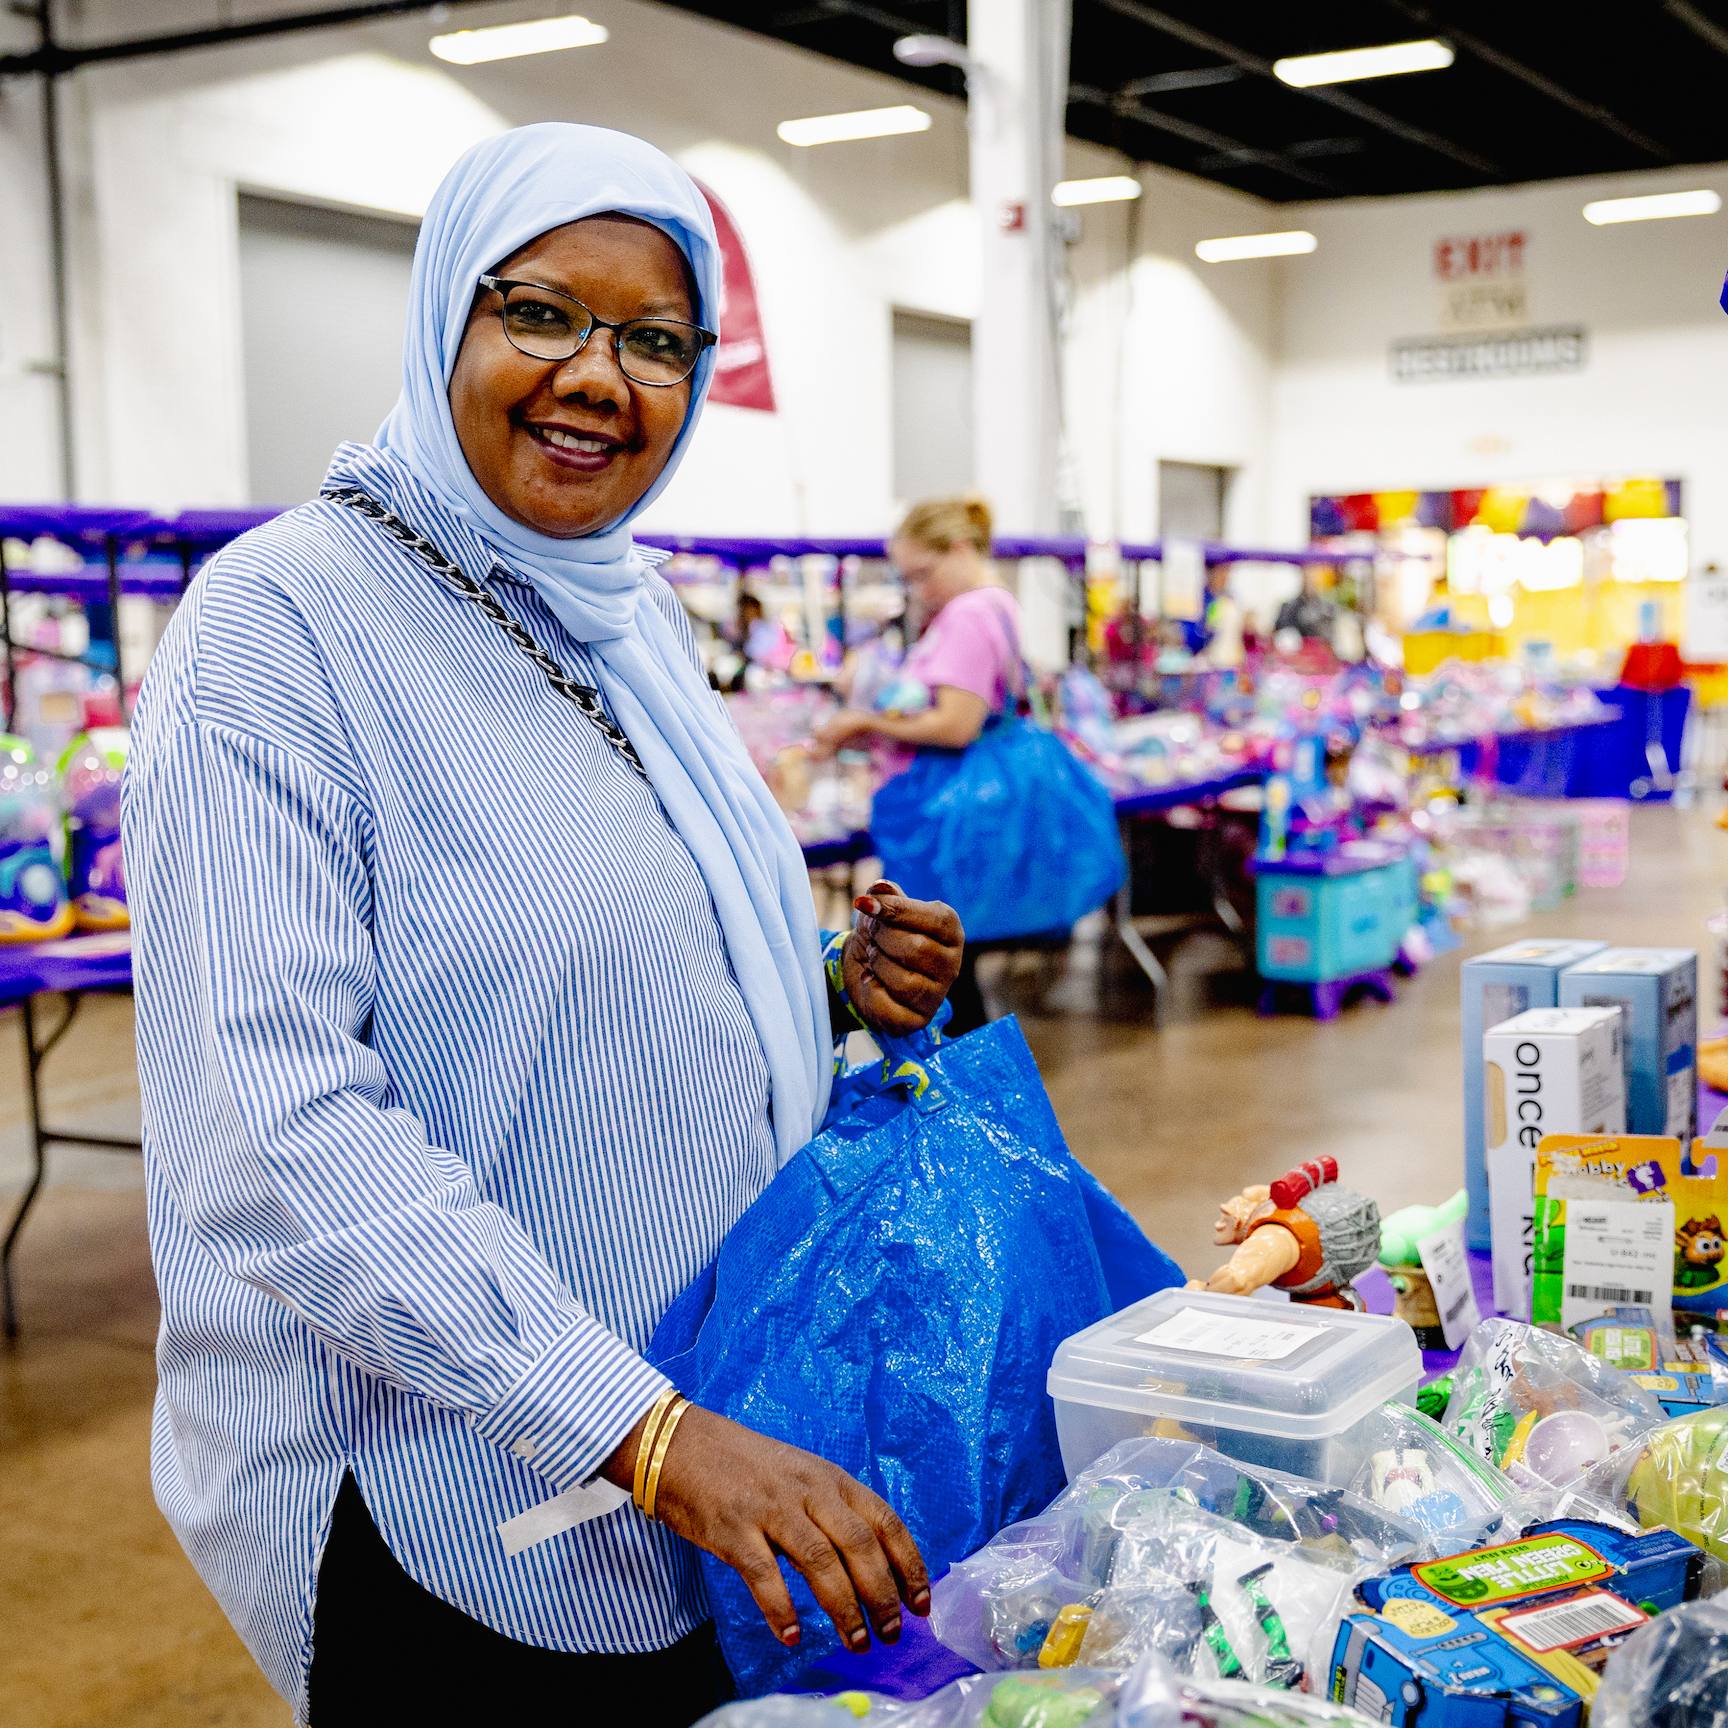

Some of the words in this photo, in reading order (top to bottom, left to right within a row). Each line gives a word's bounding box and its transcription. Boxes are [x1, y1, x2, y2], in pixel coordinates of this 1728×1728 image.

[1515, 1041, 1543, 1149] once
[1510, 1543, 1584, 1569] GREEN
[1457, 1559, 1511, 1581] MEN
[1490, 1560, 1574, 1588] LITTLE
